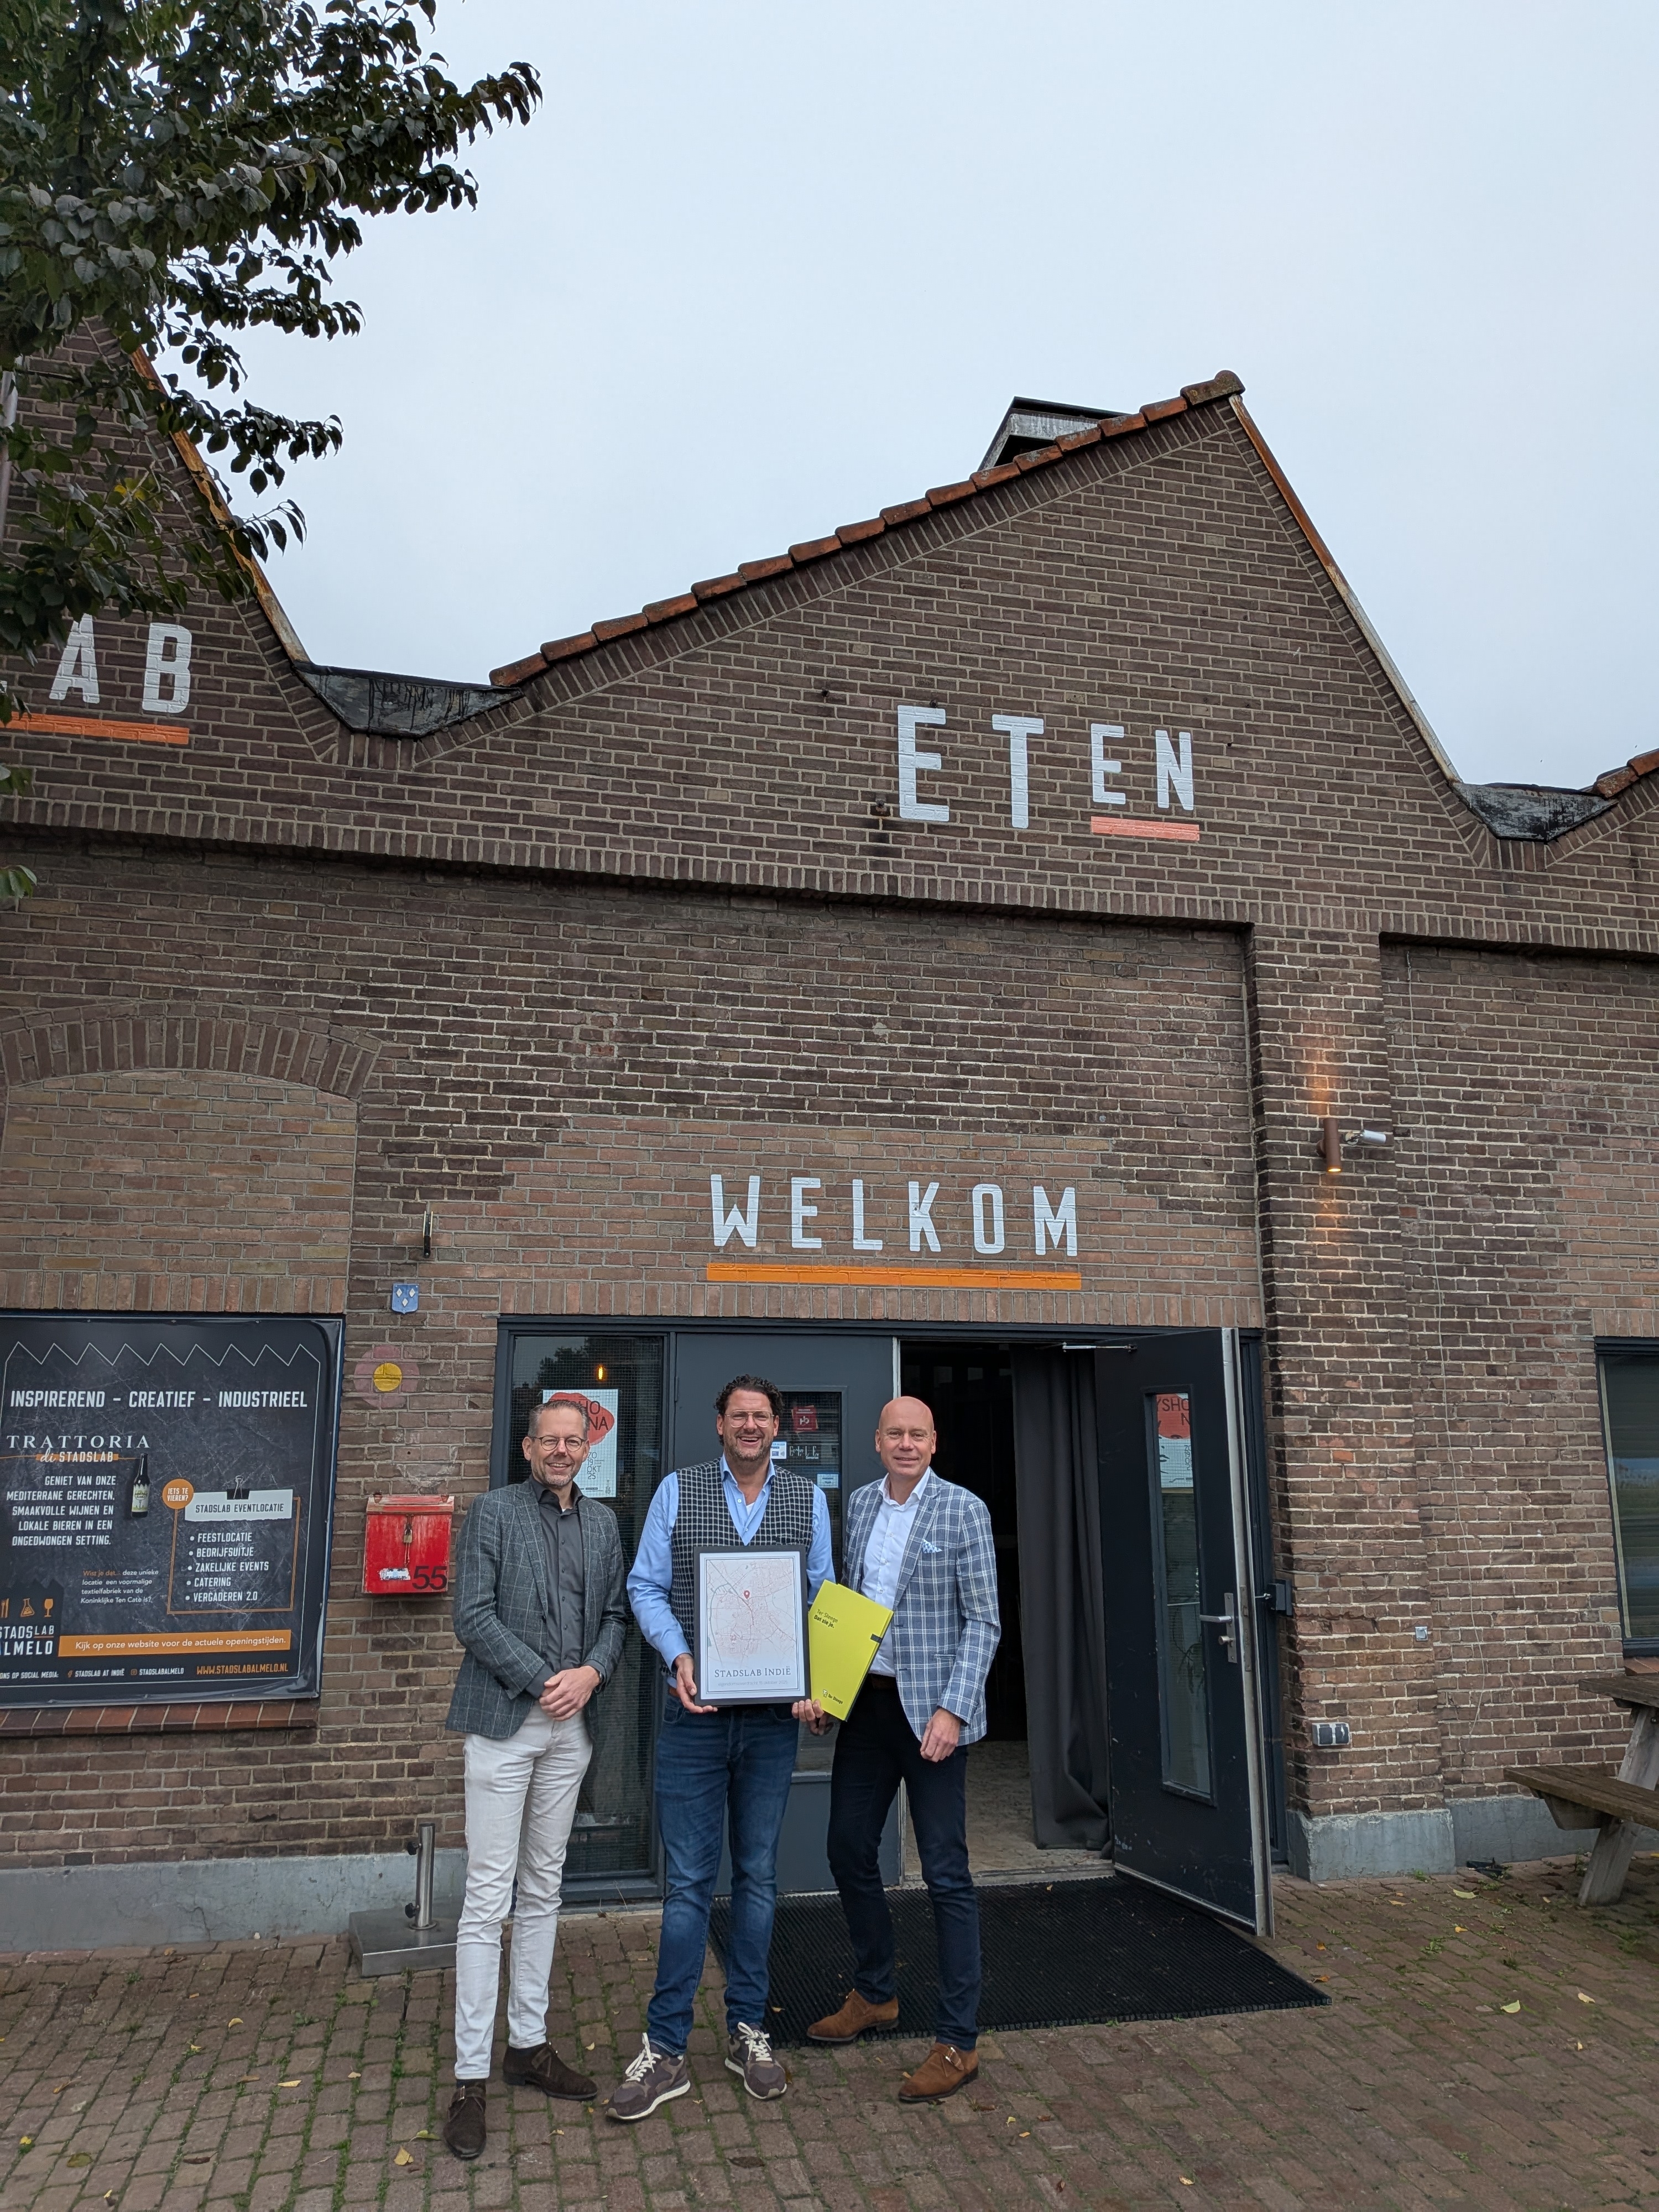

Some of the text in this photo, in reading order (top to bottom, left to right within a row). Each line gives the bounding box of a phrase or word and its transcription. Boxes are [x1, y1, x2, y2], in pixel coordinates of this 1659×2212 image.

[0, 613, 192, 713] AB
[898, 705, 1194, 828] ETEN
[711, 1174, 1078, 1256] WELKOM
[11, 1390, 105, 1407] INSPIREREND
[129, 1391, 196, 1407] CREATIEF
[218, 1391, 307, 1407] INDUSTRIEEL
[7, 1435, 150, 1448] TRATTORIA
[40, 1448, 113, 1463] di STADSLAB
[45, 1475, 116, 1486] GENIET VAN ONZE
[7, 1490, 115, 1501] MEDITERRANE GERECHTEN.
[12, 1505, 114, 1516] SMAAKVOLLE WIJNEN EN
[195, 1503, 284, 1513] STADSLAB EVENTLOCATIE
[18, 1520, 112, 1531] LOKALE BIEREN IN EEN
[12, 1535, 111, 1546] ONGEDWONGEN SETTING.
[197, 1532, 252, 1542] FEESTLOCATIE
[196, 1547, 254, 1557] BEDRIJFSUITJE
[195, 1561, 269, 1572] ZAKELIJKE EVENTS
[194, 1577, 231, 1587] CATERING
[412, 1566, 447, 1590] 55
[194, 1591, 258, 1602] VERGADEREN 2.0
[823, 1613, 838, 1623] Steege
[0, 1641, 53, 1656] LMELO
[75, 1641, 90, 1651] Kijk
[93, 1642, 104, 1651] op
[128, 1640, 159, 1648] website
[182, 1639, 192, 1647] de
[195, 1637, 223, 1646] actuele
[226, 1636, 286, 1646] openingstijden.
[139, 1667, 185, 1676] STADSLABALMELO
[197, 1663, 288, 1675] WWW.STADSLABALMELO.NL
[714, 1666, 791, 1678] STADSLAB INDIË
